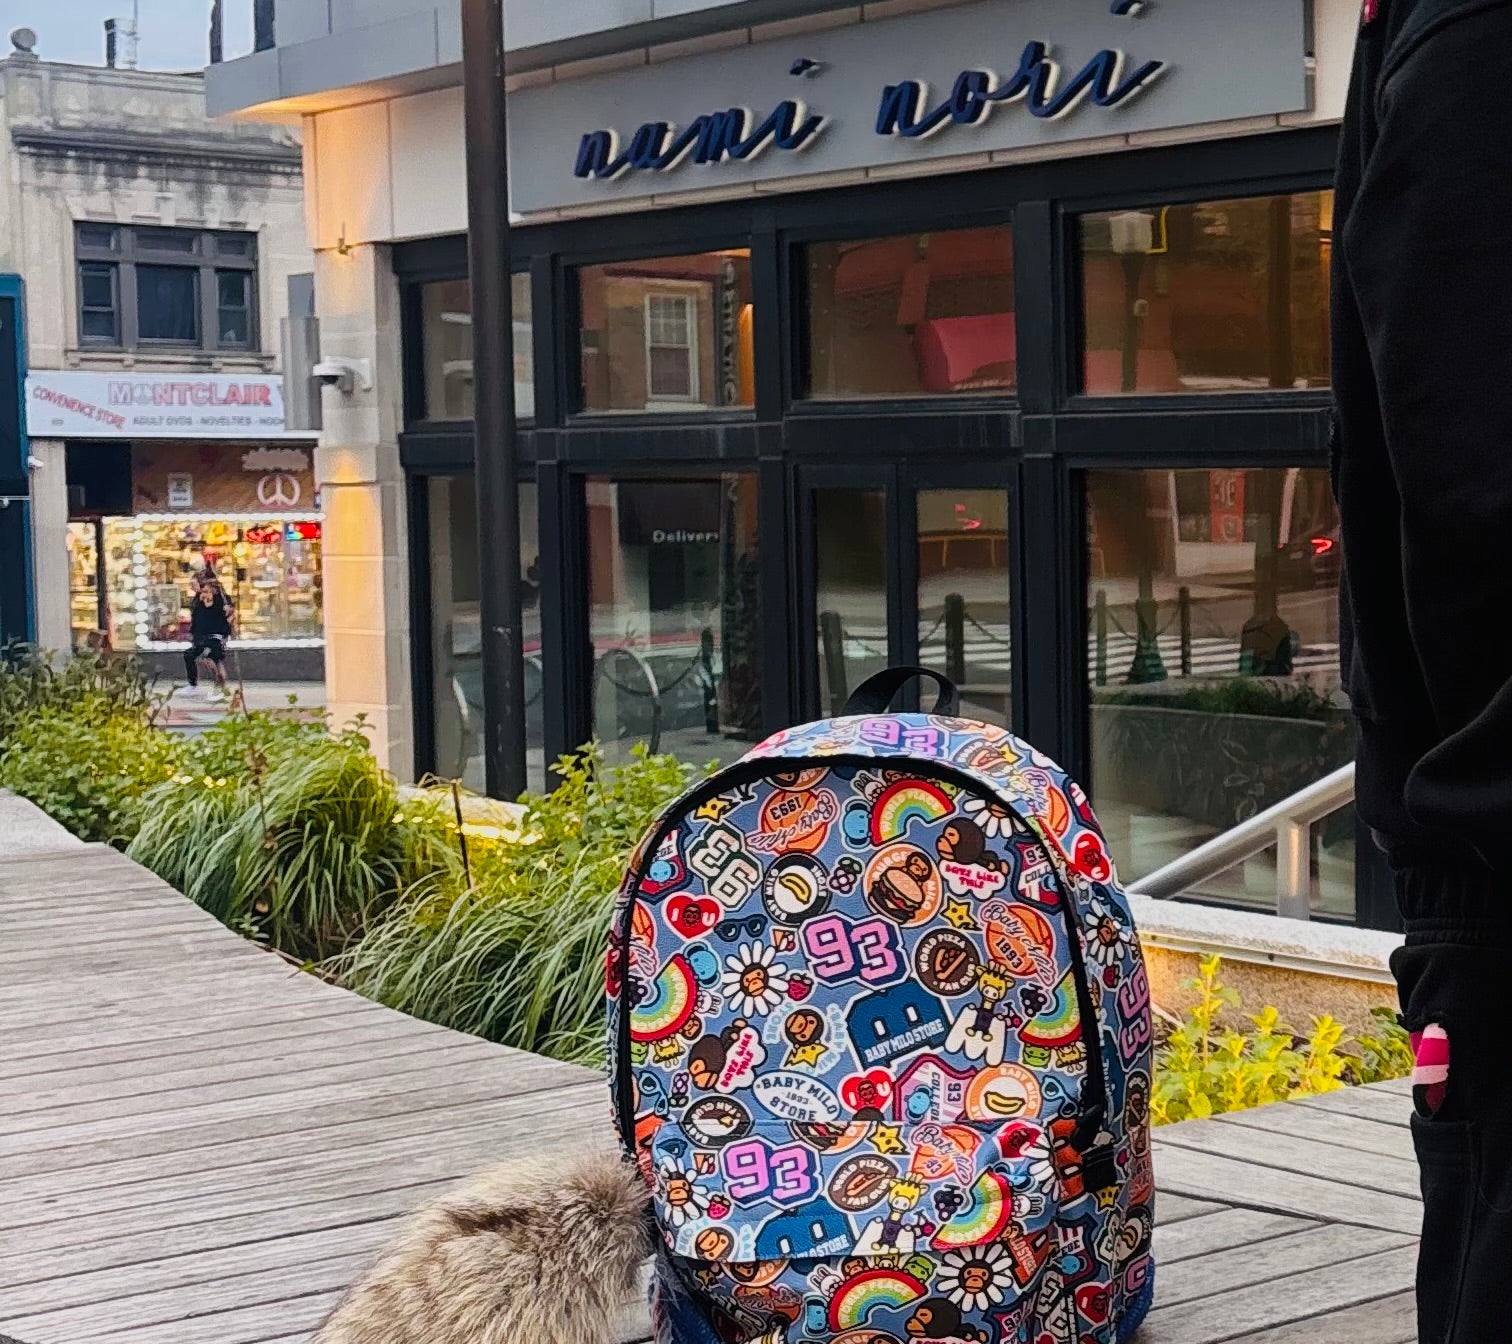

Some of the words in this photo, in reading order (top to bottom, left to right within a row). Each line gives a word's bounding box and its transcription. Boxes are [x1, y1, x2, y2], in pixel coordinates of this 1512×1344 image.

[574, 57, 830, 179] nami
[984, 903, 1025, 939] Baby
[805, 918, 899, 981] 93
[920, 937, 937, 973] WORLD
[937, 933, 966, 949] PIZZA
[938, 979, 960, 991] FAN
[959, 963, 977, 987] CLUB
[863, 1040, 893, 1063] BABY
[891, 1033, 916, 1055] MILO
[913, 1018, 945, 1043] STORE
[761, 1076, 807, 1091] BABY
[807, 1084, 838, 1115] MILO
[769, 1096, 818, 1121] STORE
[947, 1082, 962, 1102] 93
[725, 1141, 812, 1200] 93
[832, 1163, 858, 1192] WORLD
[858, 1159, 890, 1174] PIZZA
[846, 1195, 869, 1206] FAN
